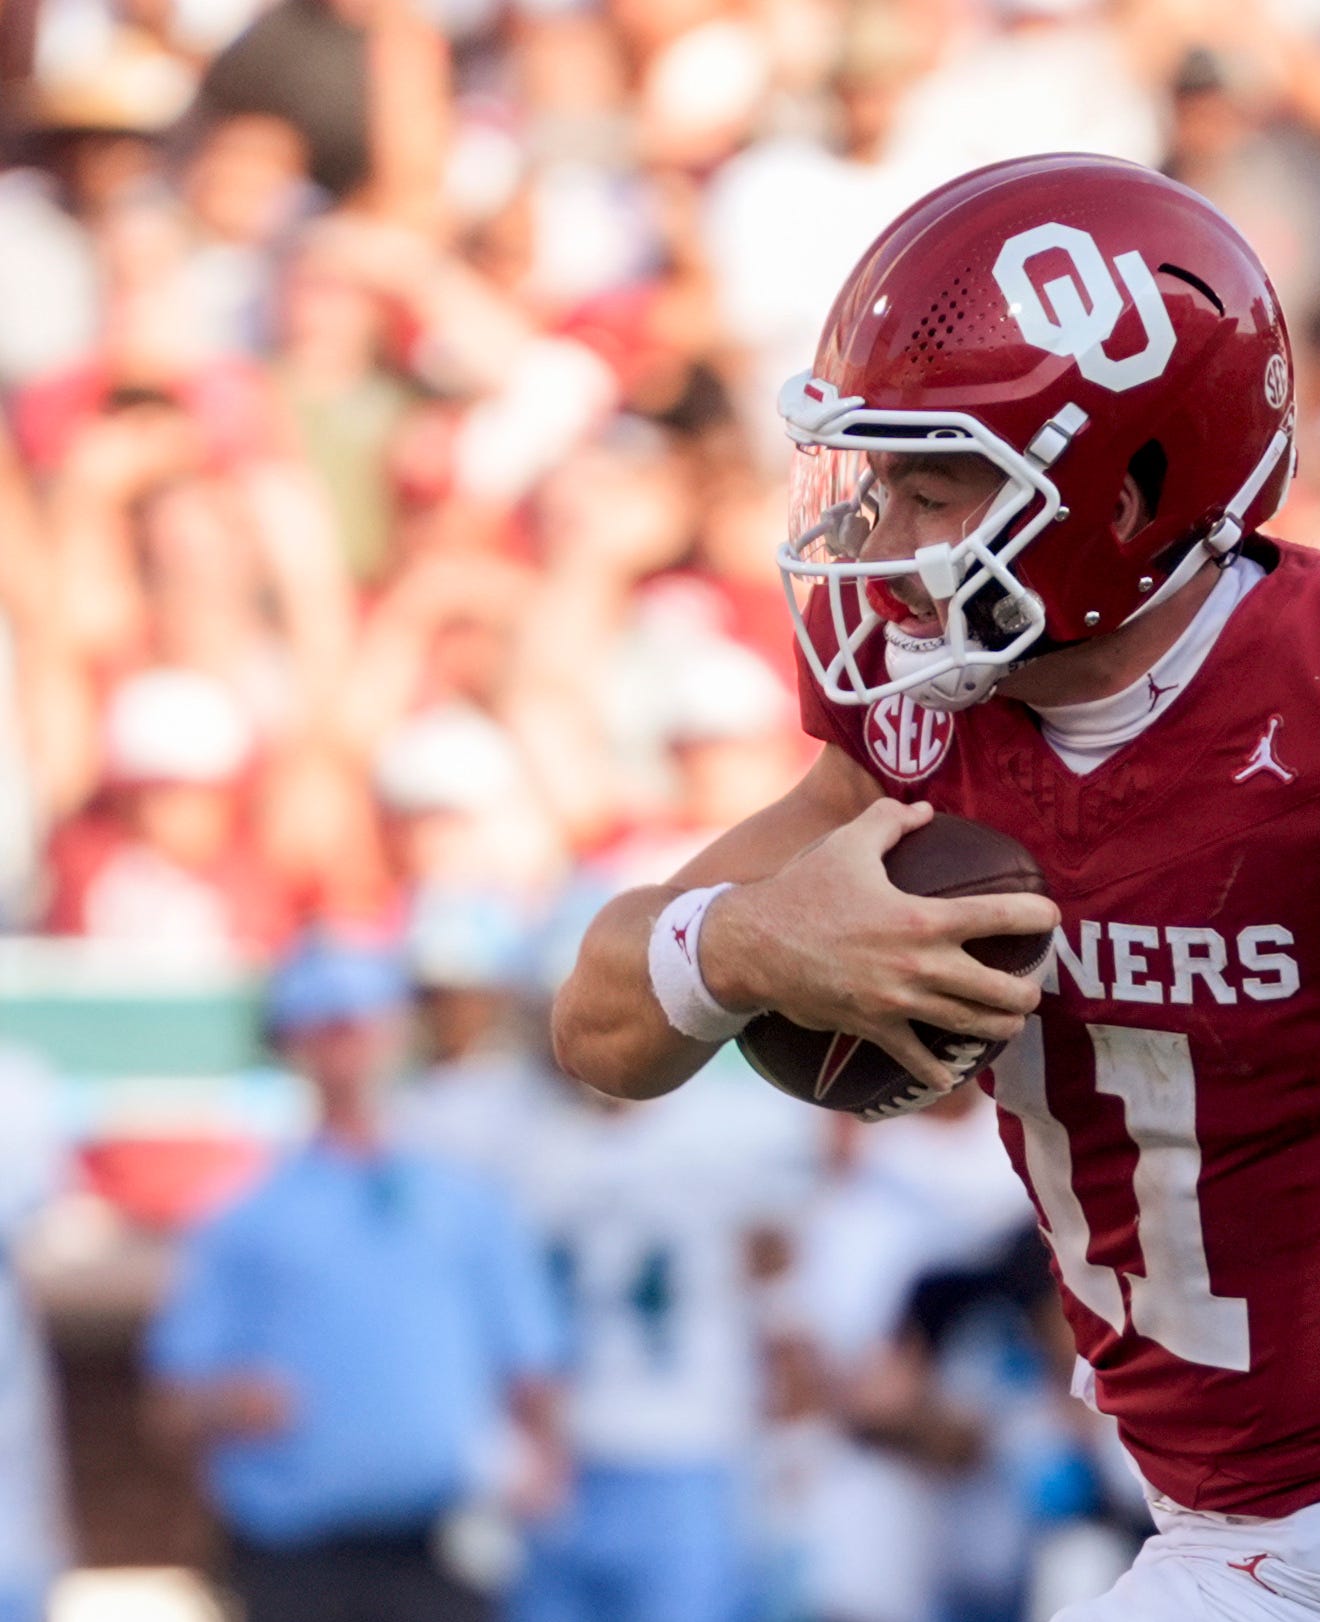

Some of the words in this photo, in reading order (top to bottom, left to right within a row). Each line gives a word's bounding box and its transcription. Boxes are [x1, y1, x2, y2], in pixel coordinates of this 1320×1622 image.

[992, 221, 1177, 393] OU
[872, 690, 946, 774] SEC
[1040, 919, 1301, 1004] NERS
[990, 1012, 1250, 1372] 11
